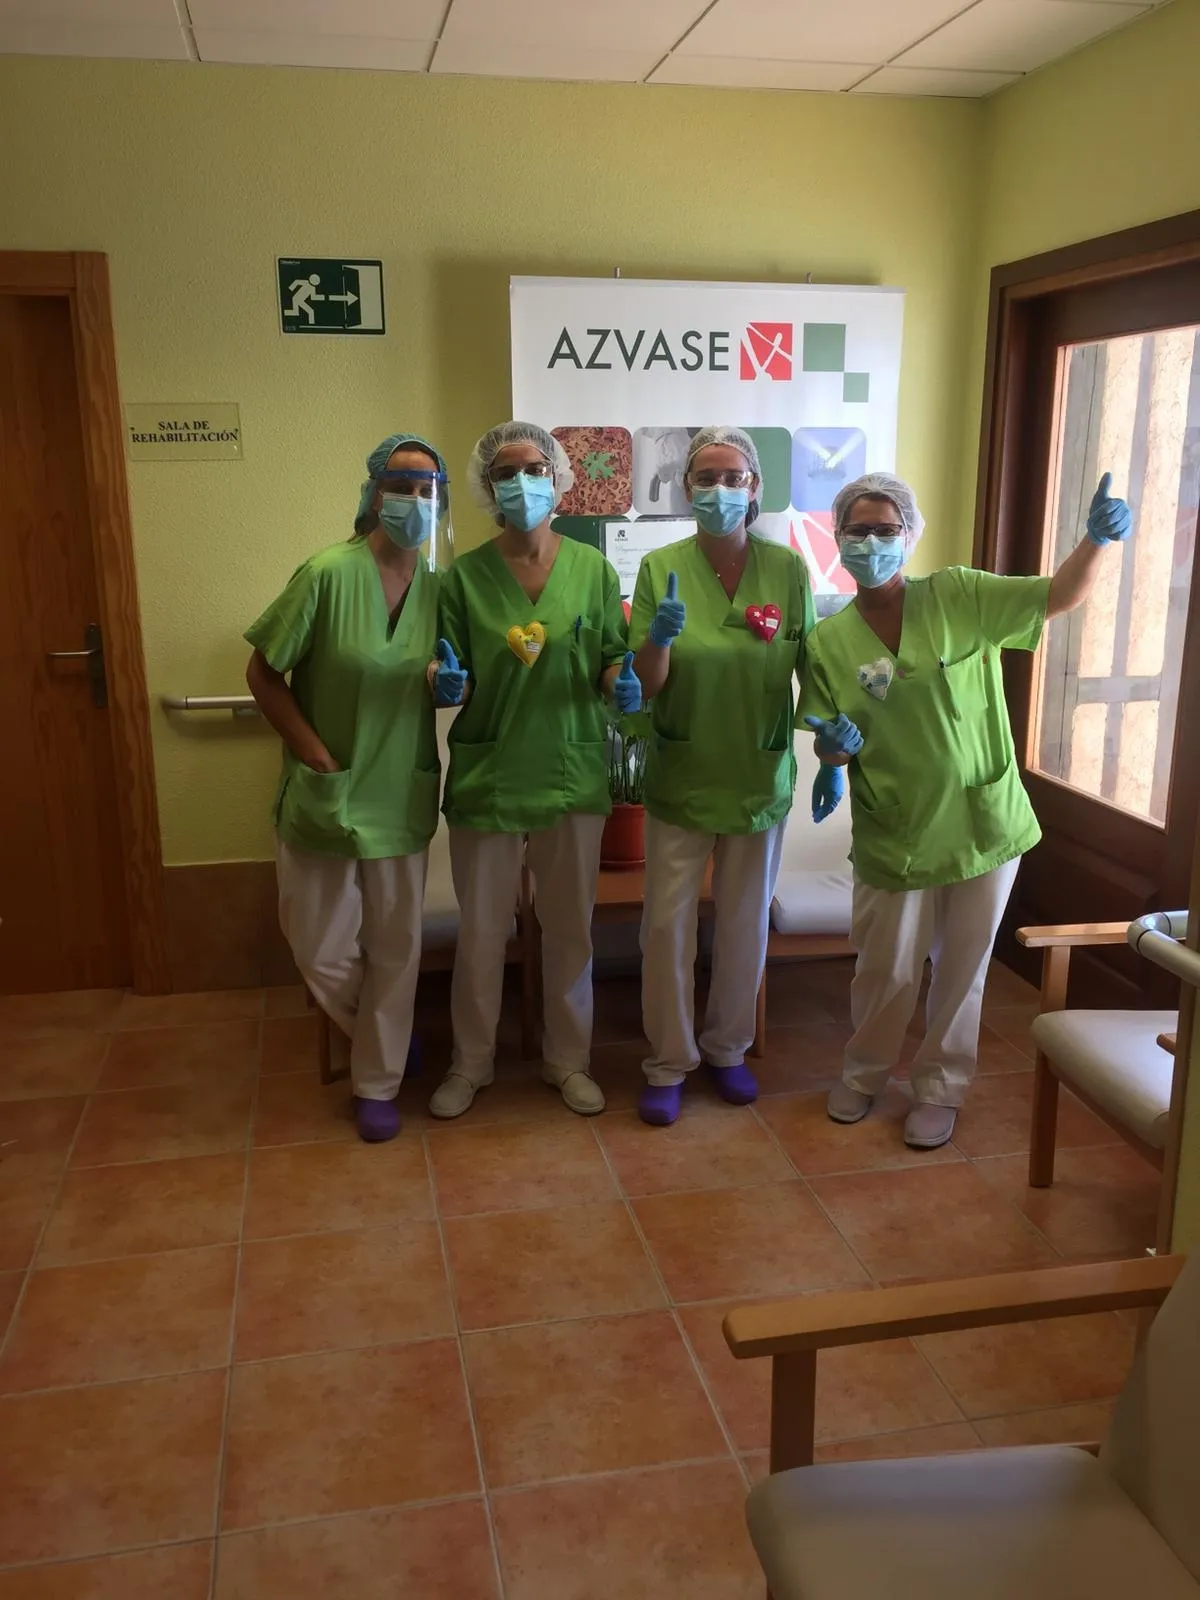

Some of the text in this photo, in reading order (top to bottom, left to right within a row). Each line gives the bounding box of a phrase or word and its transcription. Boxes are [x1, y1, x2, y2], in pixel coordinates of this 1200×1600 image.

[547, 326, 730, 372] AZVASE
[158, 420, 210, 431] SALA DE
[132, 430, 238, 443] REHABILITACIÓN
